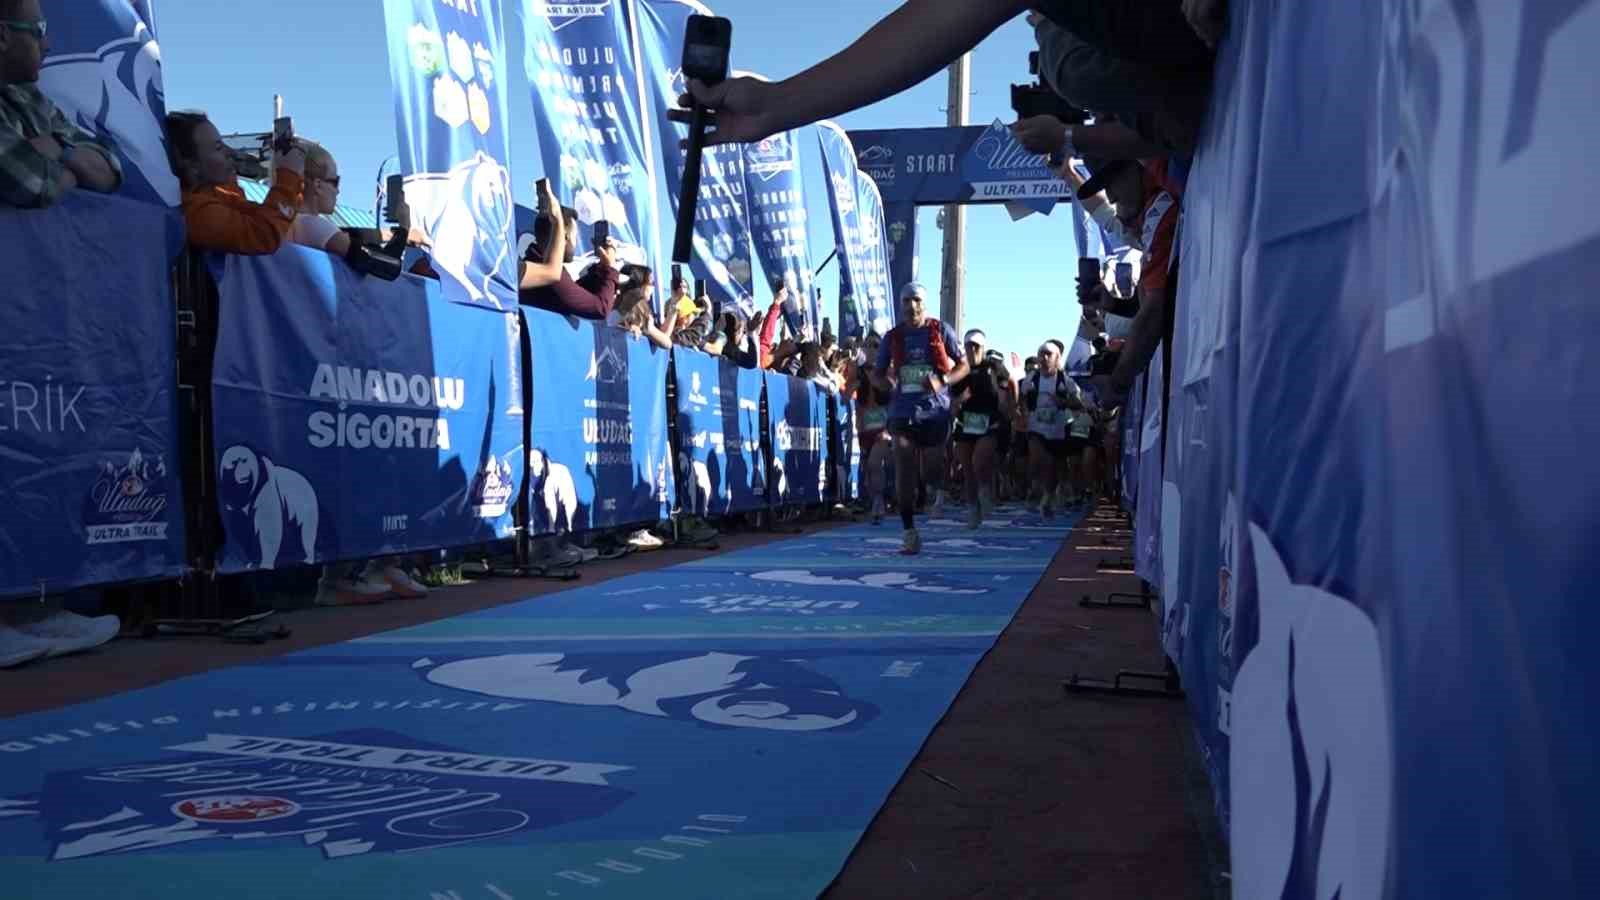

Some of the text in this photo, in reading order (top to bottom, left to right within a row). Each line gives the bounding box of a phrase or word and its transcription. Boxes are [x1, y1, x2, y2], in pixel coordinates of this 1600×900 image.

[905, 153, 956, 174] START
[983, 184, 1027, 197] ULTRA
[309, 362, 465, 411] ANADOLU
[307, 400, 451, 450] SİGORTA
[94, 524, 131, 540] ULTRA
[225, 738, 568, 777] ULTRA TRAIL
